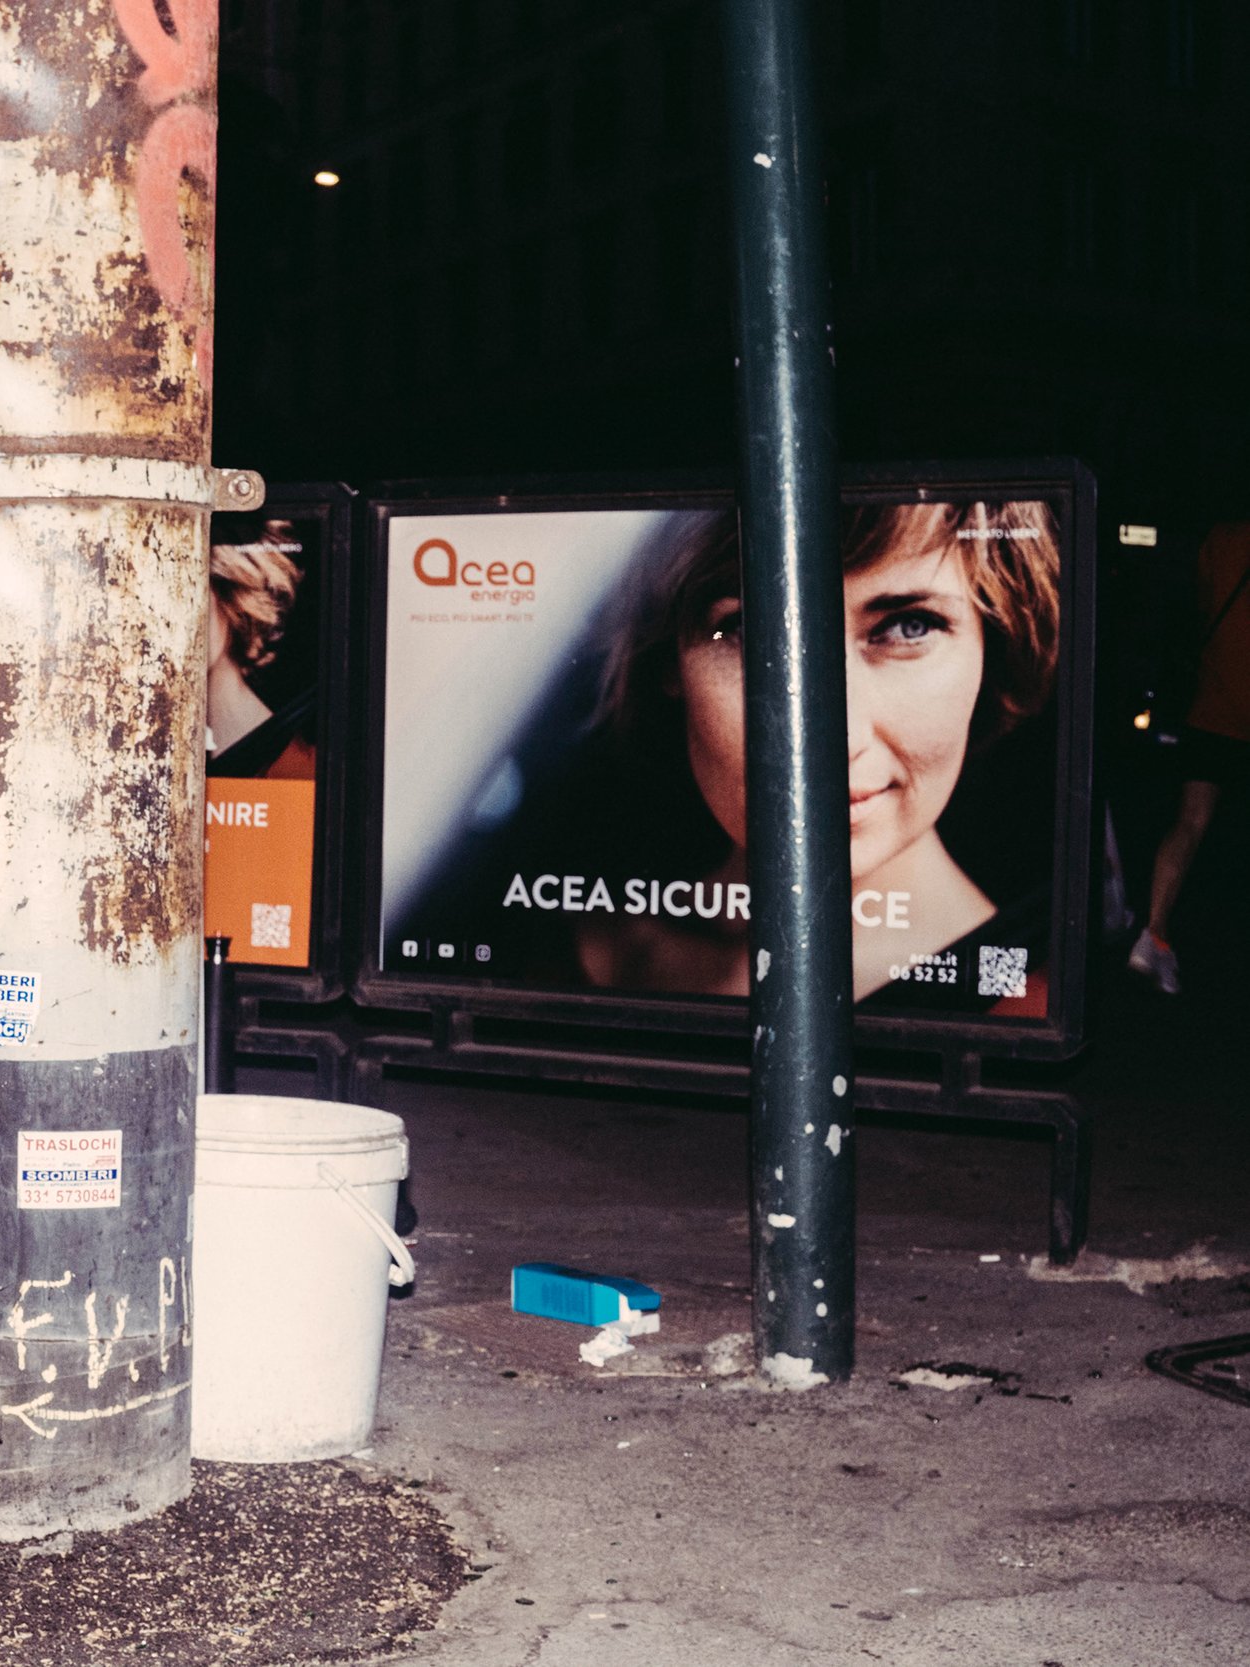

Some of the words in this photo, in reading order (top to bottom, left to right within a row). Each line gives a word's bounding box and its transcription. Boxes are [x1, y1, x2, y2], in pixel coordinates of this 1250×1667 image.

[413, 538, 535, 586] acea
[470, 590, 535, 606] energia
[504, 873, 616, 913] ACEA
[623, 878, 751, 921] SICUR
[888, 964, 911, 981] 06
[914, 966, 933, 982] 52
[937, 967, 957, 984] 52
[24, 1137, 117, 1151] TRASLOCHI
[26, 1169, 114, 1181] SGOMBERI
[56, 1188, 116, 1203] 5730844
